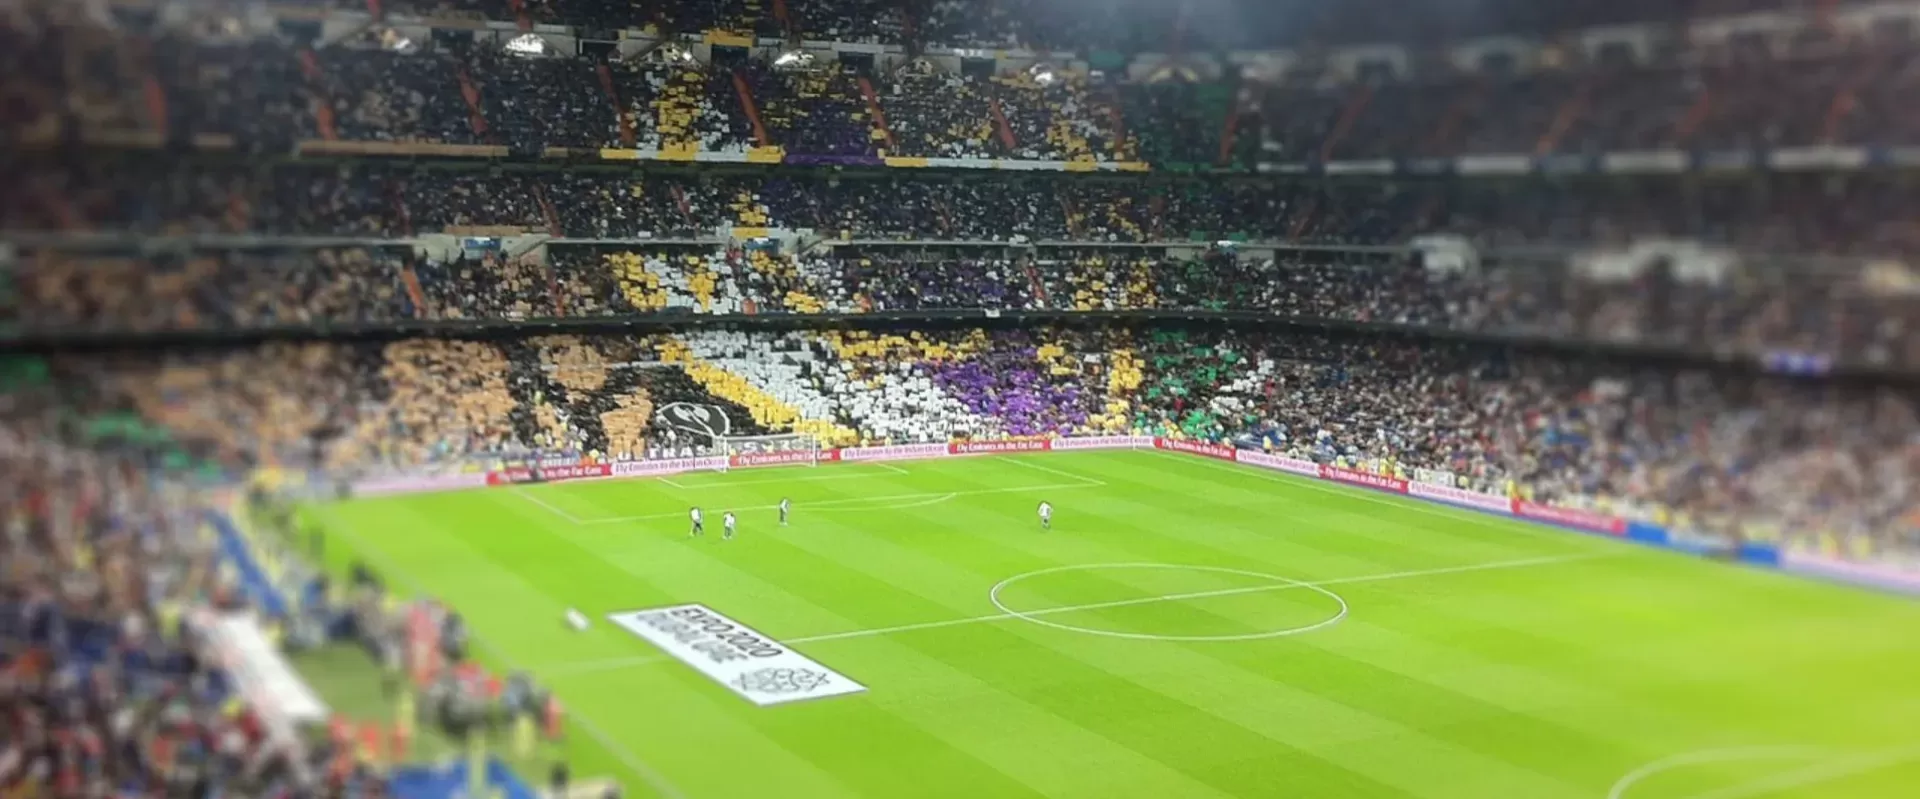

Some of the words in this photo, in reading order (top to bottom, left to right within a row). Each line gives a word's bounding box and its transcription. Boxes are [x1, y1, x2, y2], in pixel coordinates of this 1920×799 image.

[969, 442, 997, 451] Emirates
[617, 444, 707, 460] UTRAS
[856, 448, 885, 457] Emirates
[752, 454, 782, 464] Emirates
[585, 465, 602, 475] East
[629, 459, 659, 471] Emirates
[670, 607, 734, 633] EXPO
[716, 631, 783, 658] 2020
